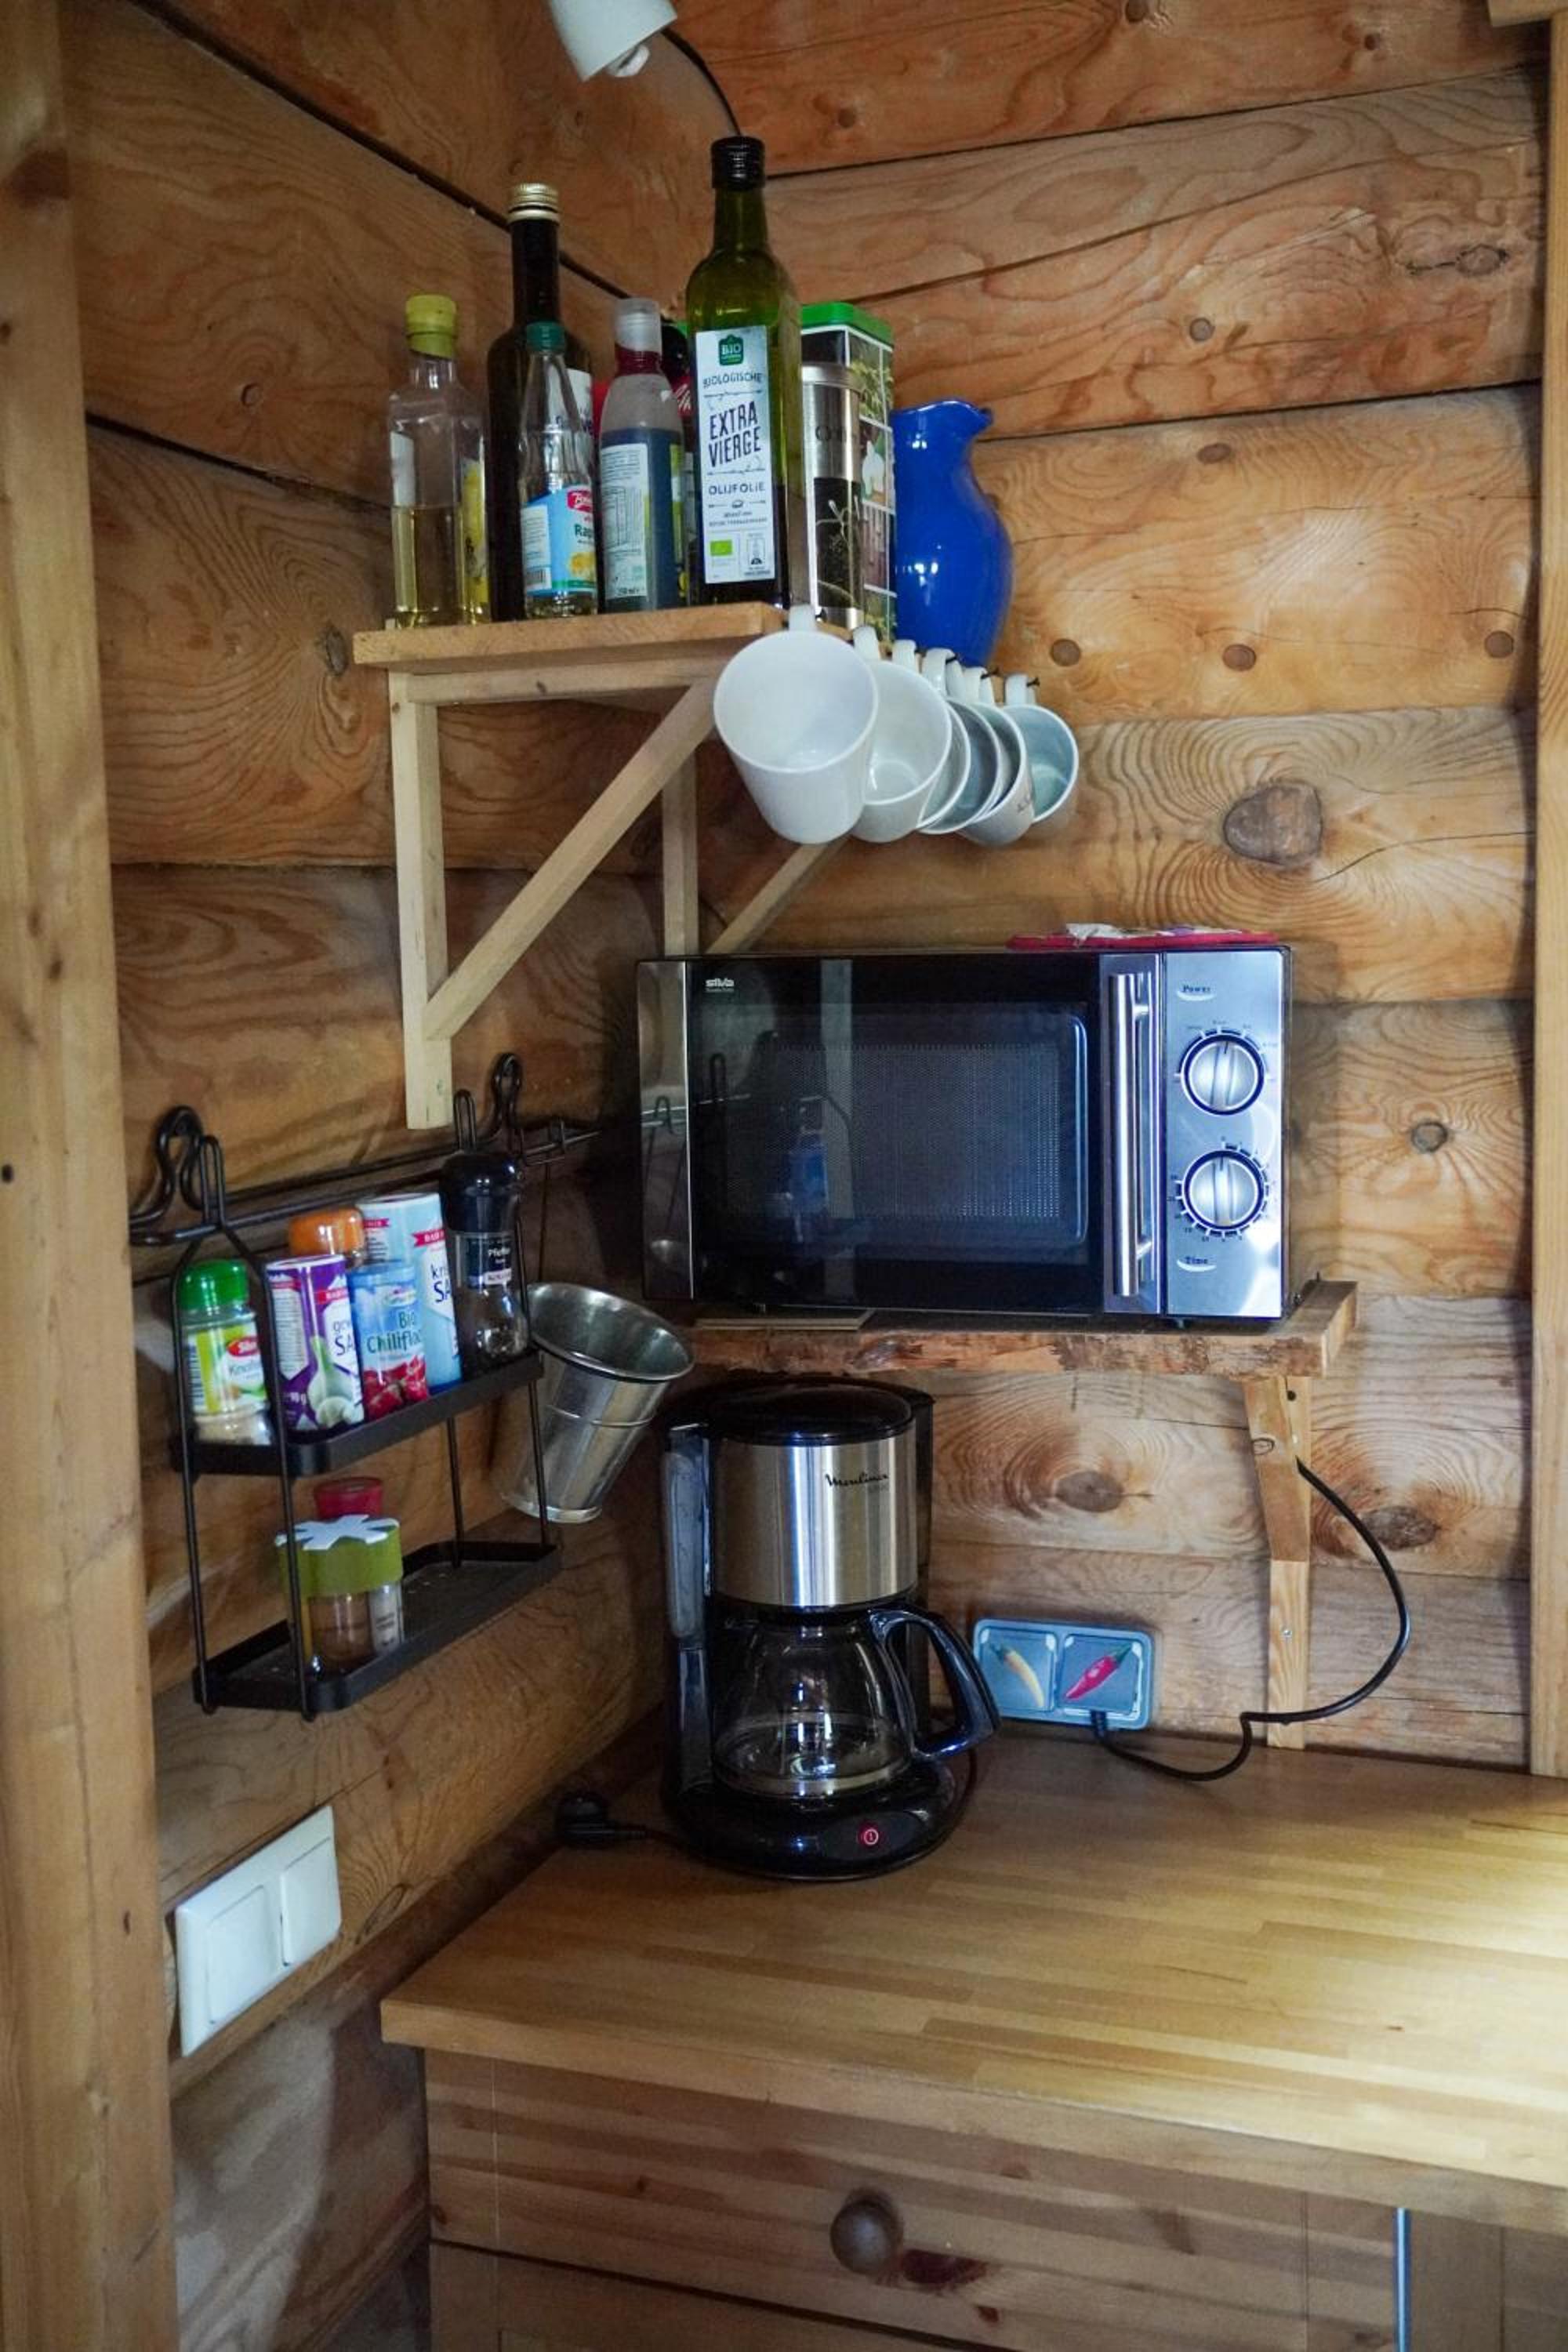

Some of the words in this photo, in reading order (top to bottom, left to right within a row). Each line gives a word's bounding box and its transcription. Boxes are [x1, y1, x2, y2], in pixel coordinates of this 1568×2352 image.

[721, 343, 742, 355] BIO
[703, 372, 763, 389] BIOLOGISCHE
[710, 401, 758, 440] EXTRA
[709, 426, 761, 467] VIERGE
[708, 481, 766, 495] OLIJFOLIE
